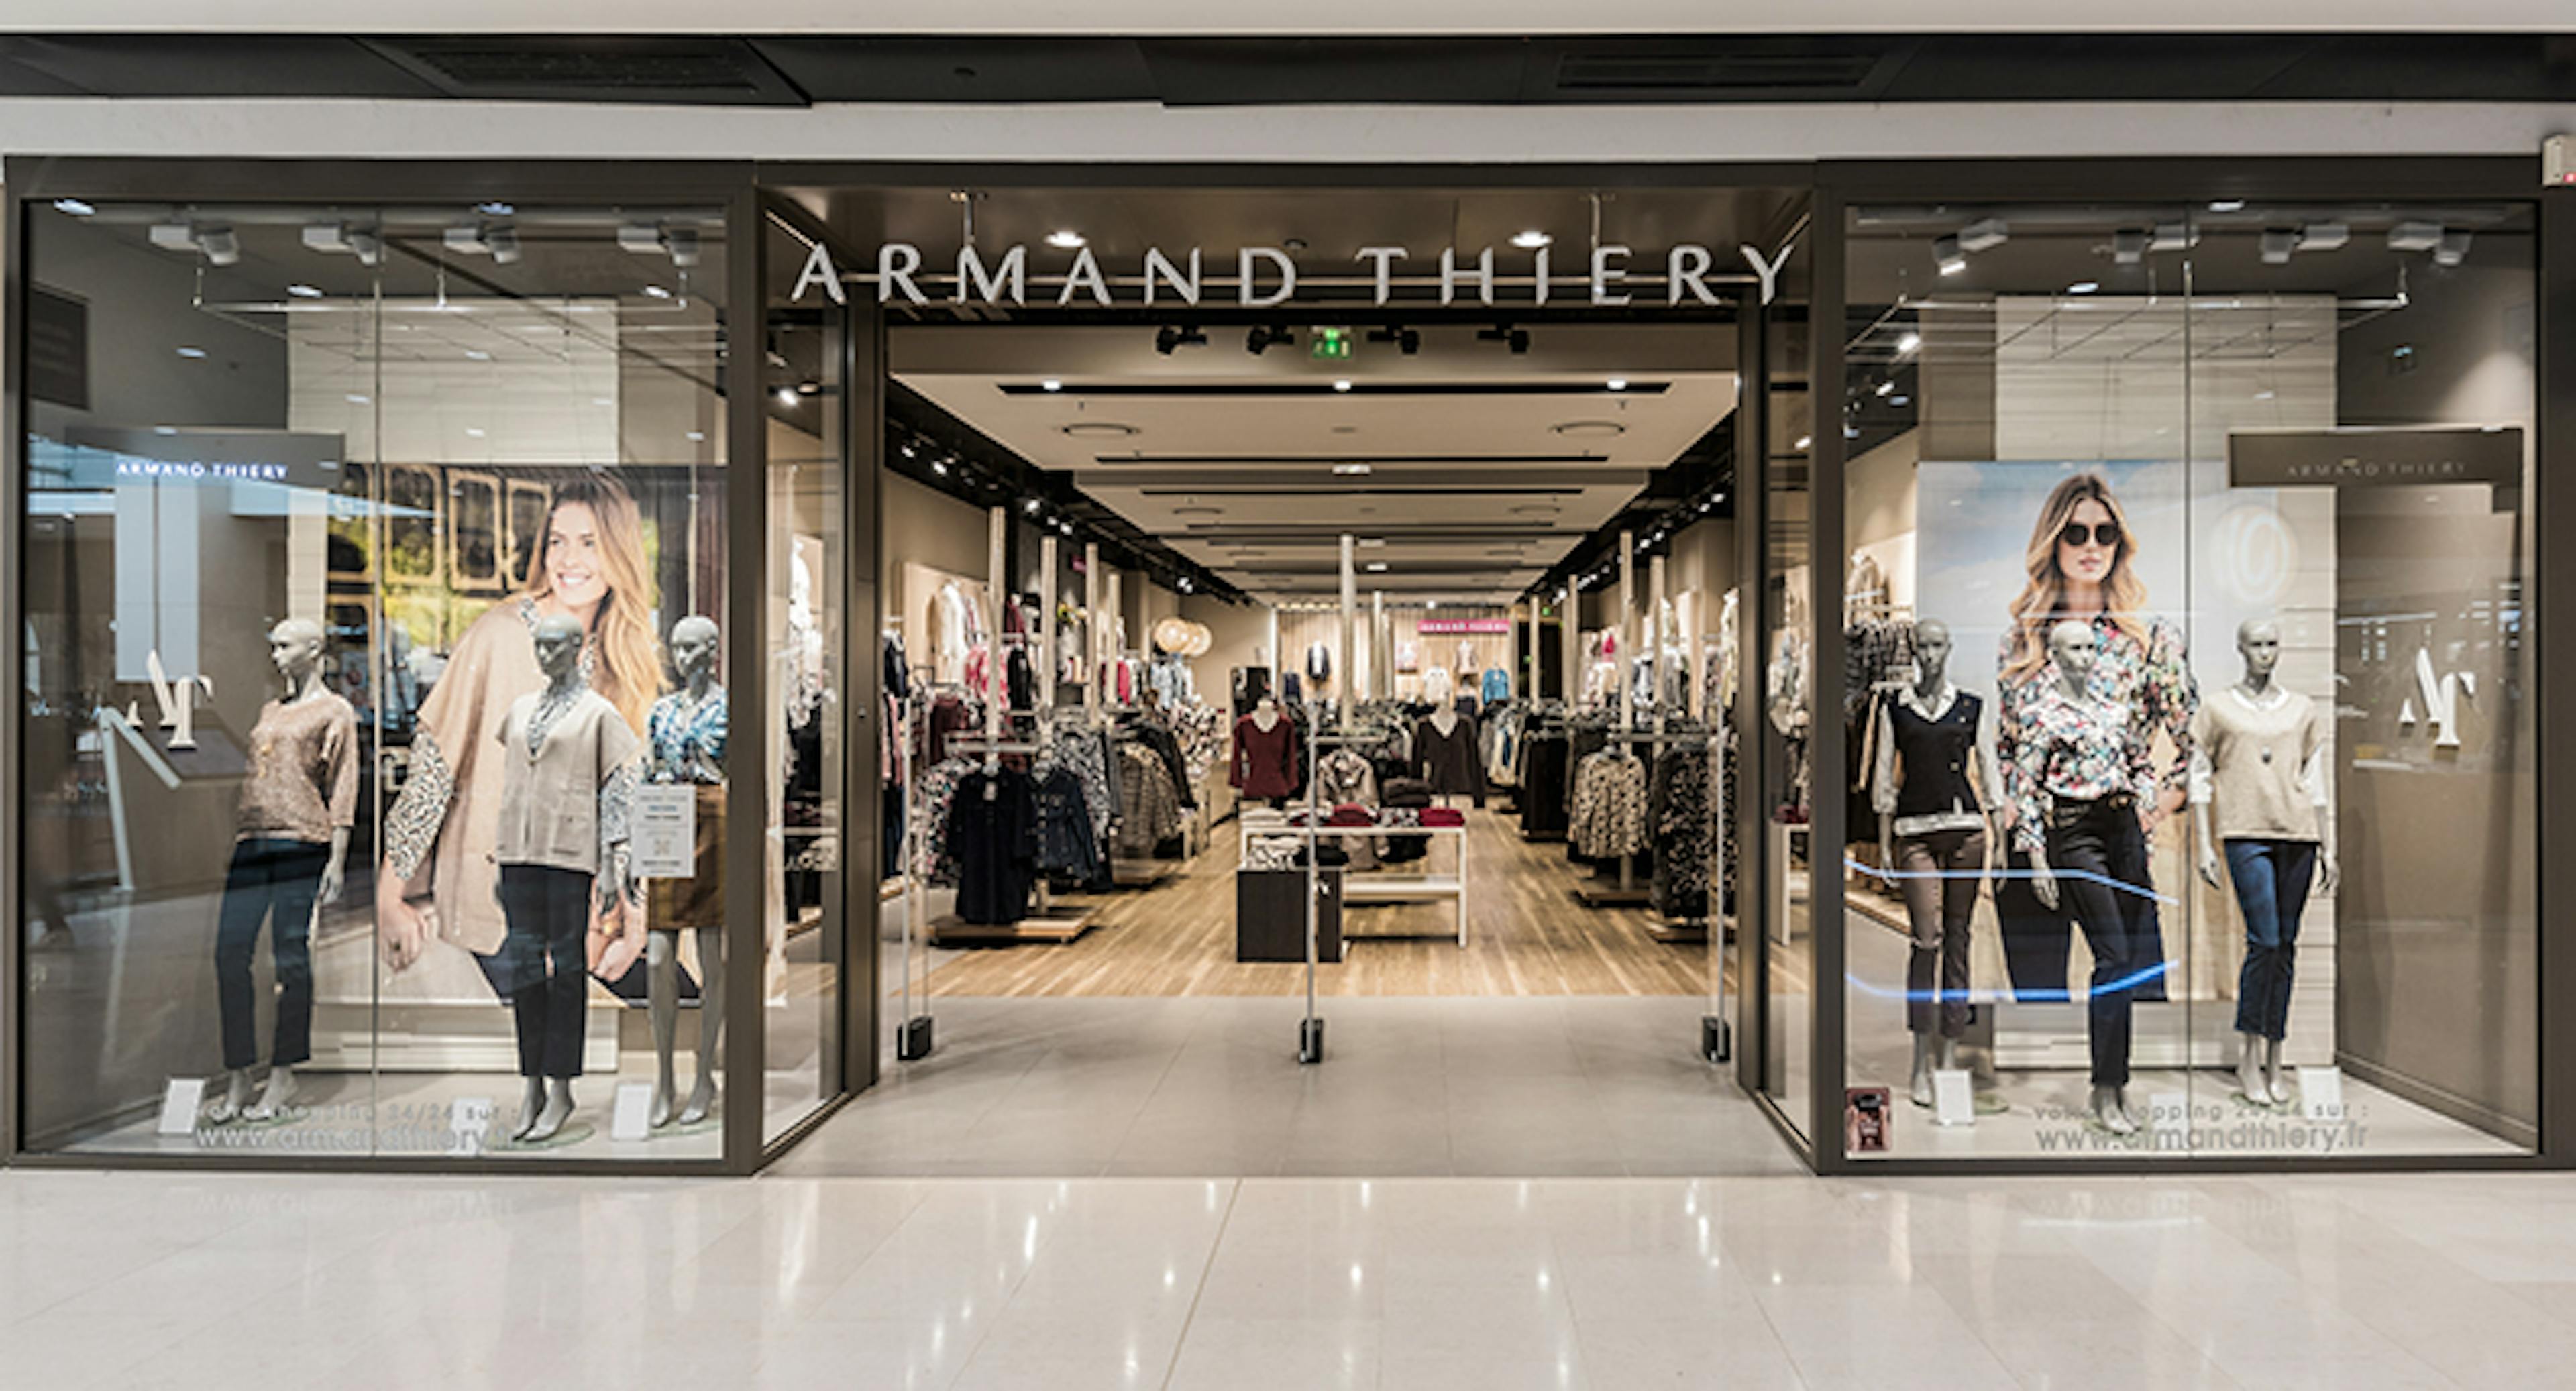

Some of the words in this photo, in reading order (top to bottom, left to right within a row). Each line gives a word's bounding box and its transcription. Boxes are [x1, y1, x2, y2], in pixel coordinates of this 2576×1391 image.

[791, 243, 1297, 306] ARMAND
[1354, 244, 1795, 306] THIERY
[2315, 1103, 2350, 1117] sur
